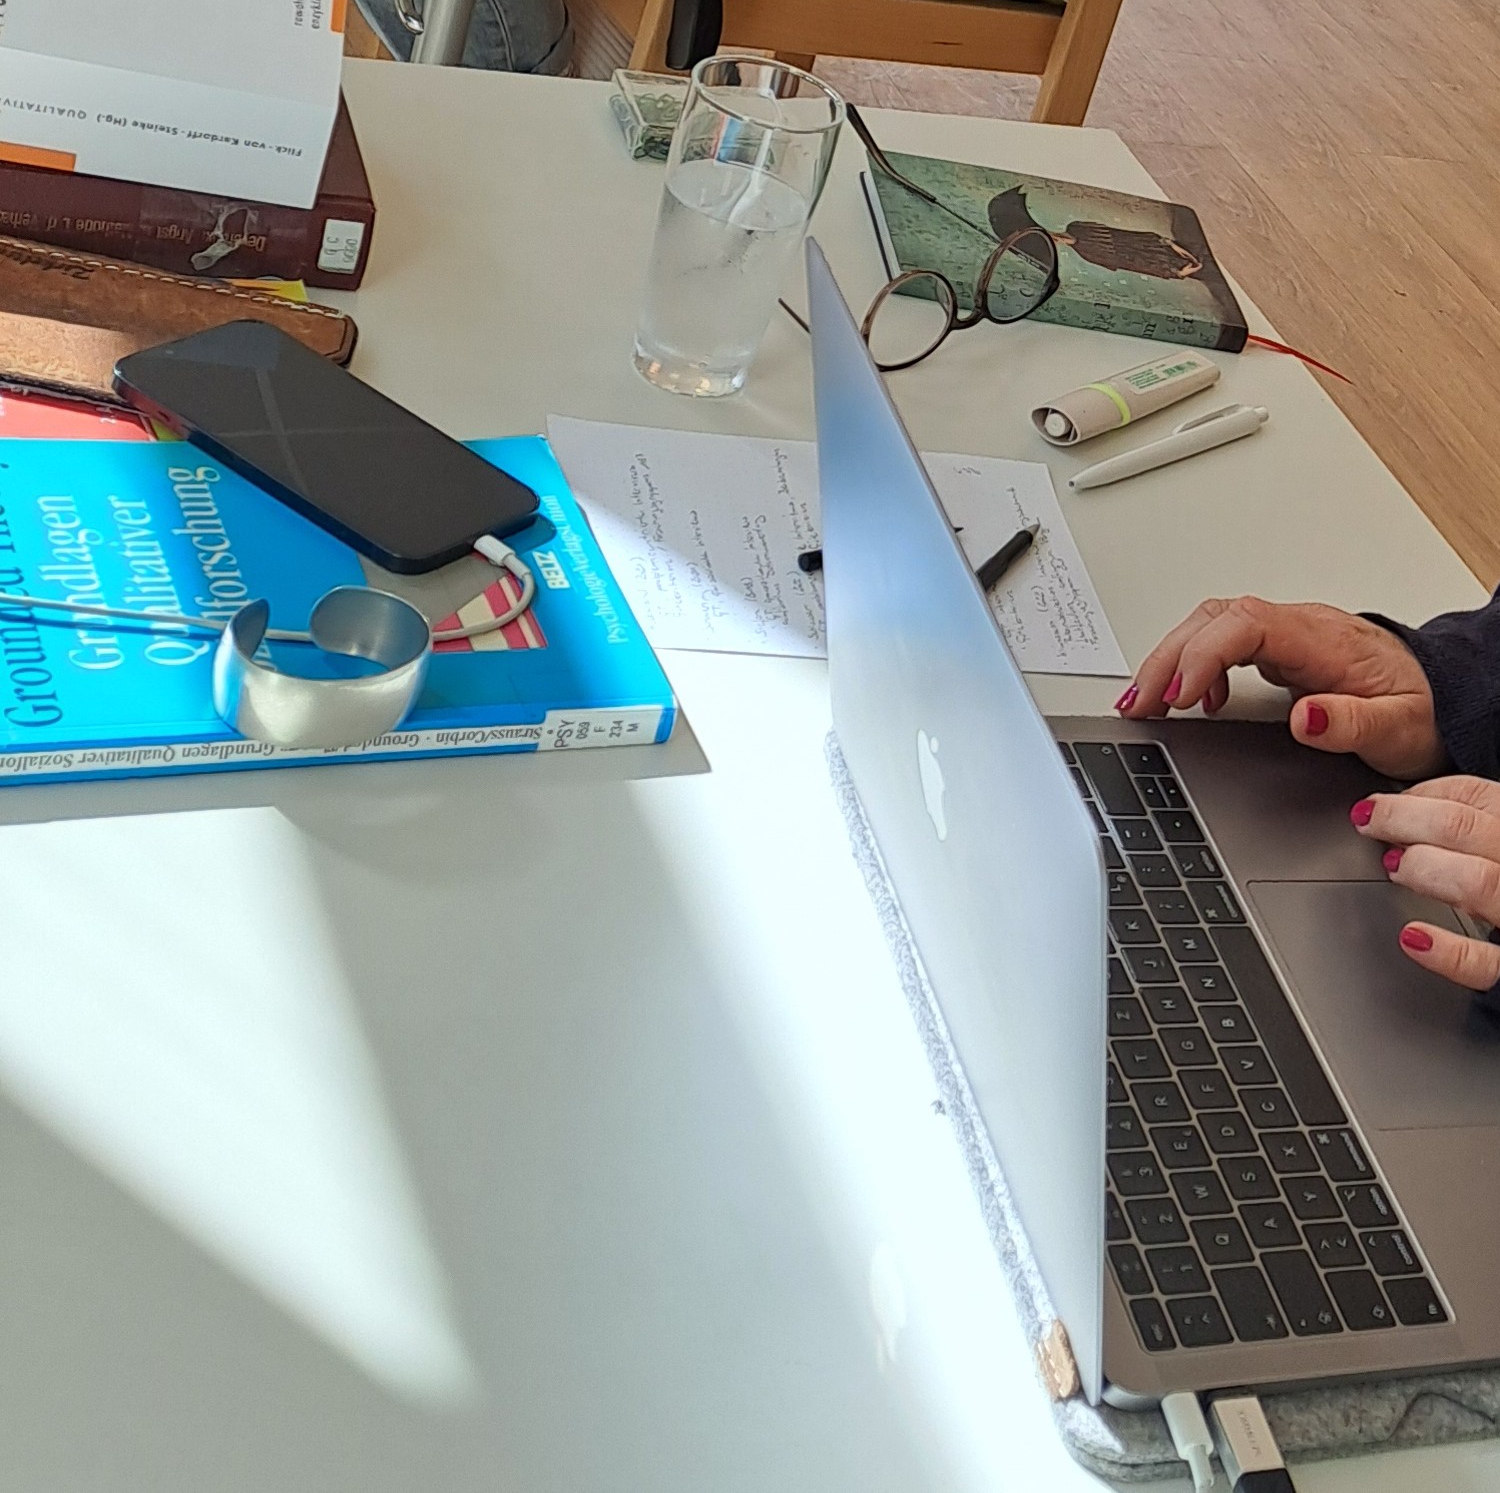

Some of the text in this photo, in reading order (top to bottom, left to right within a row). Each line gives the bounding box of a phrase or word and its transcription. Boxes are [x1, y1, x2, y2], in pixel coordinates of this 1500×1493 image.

[0, 97, 303, 157] Flick von Kardorff Steinke (Hg.) QUALITATIV
[533, 551, 570, 588] BELTZ
[343, 733, 420, 753] Ground
[436, 725, 542, 749] Strauss/Corbin
[553, 719, 575, 748] PSY
[77, 744, 175, 765] Qualitativer
[182, 741, 275, 761] Grundlagen
